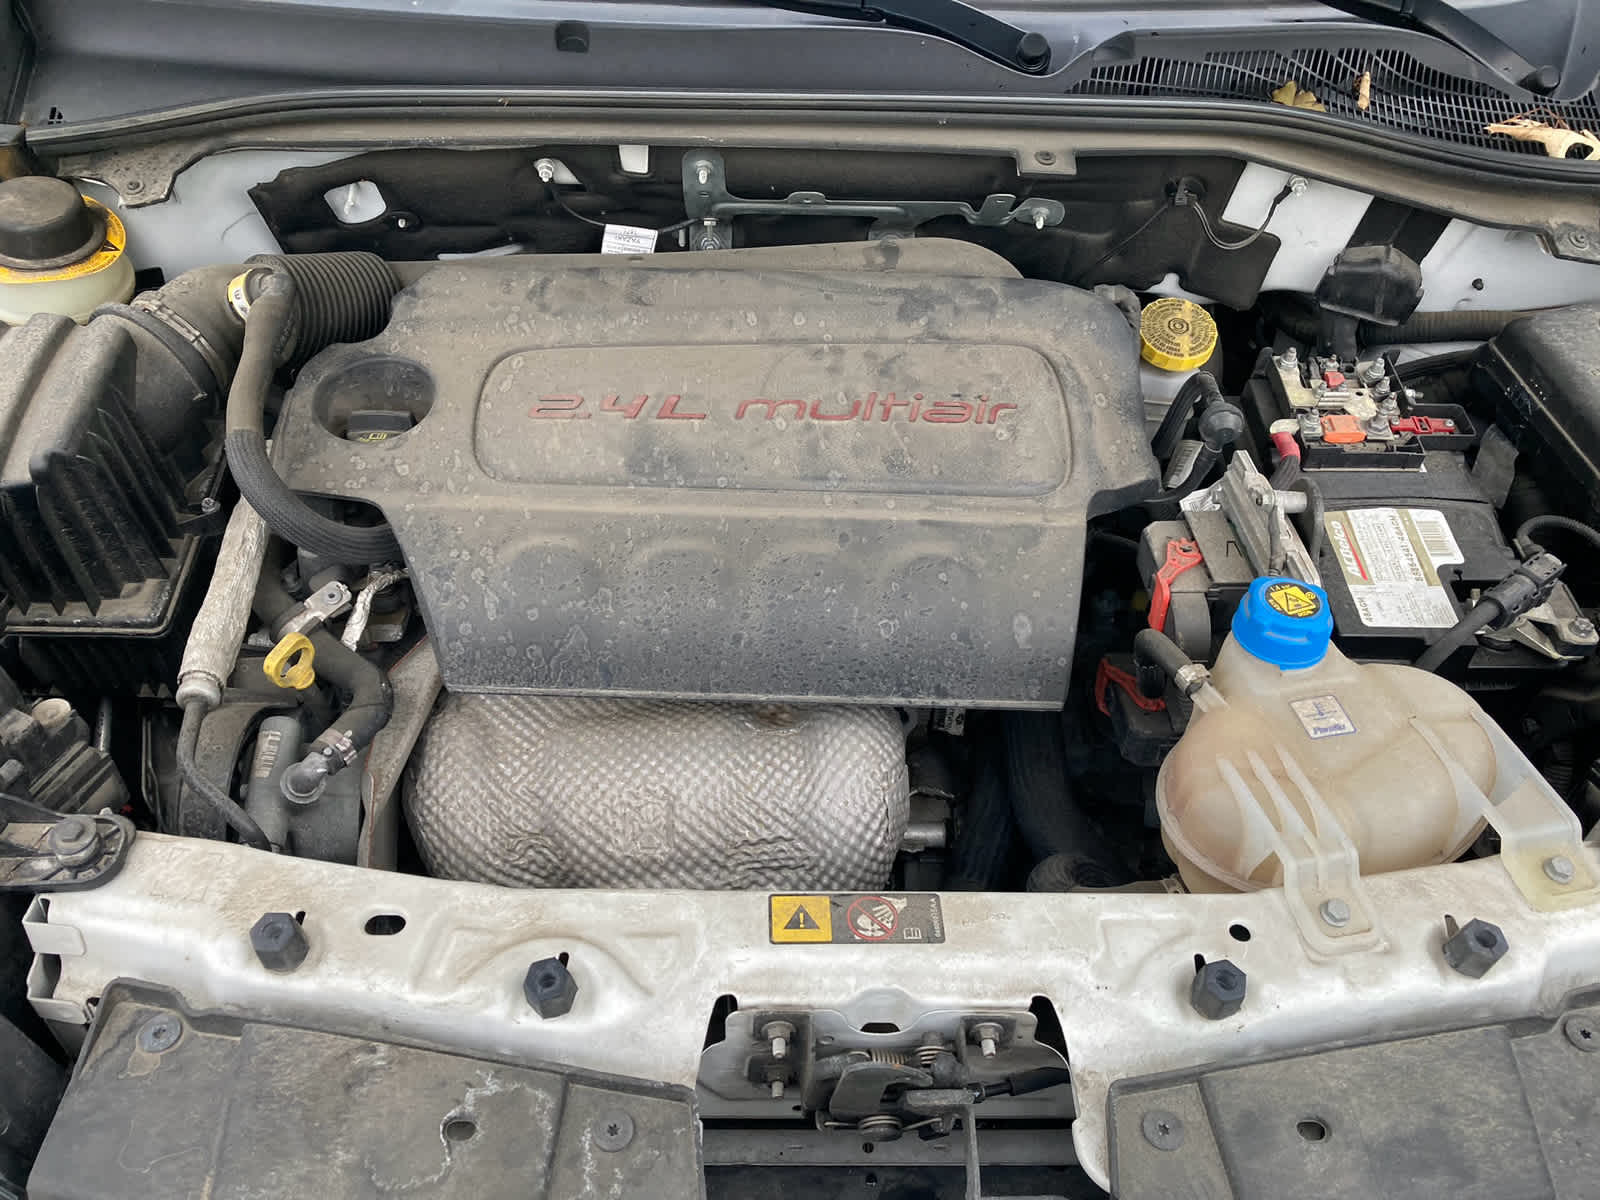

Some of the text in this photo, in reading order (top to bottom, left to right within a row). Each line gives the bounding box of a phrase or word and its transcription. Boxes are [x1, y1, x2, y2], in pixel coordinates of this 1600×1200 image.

[528, 392, 1017, 424] 2.4L multiair
[1330, 519, 1362, 578] ACDelco
